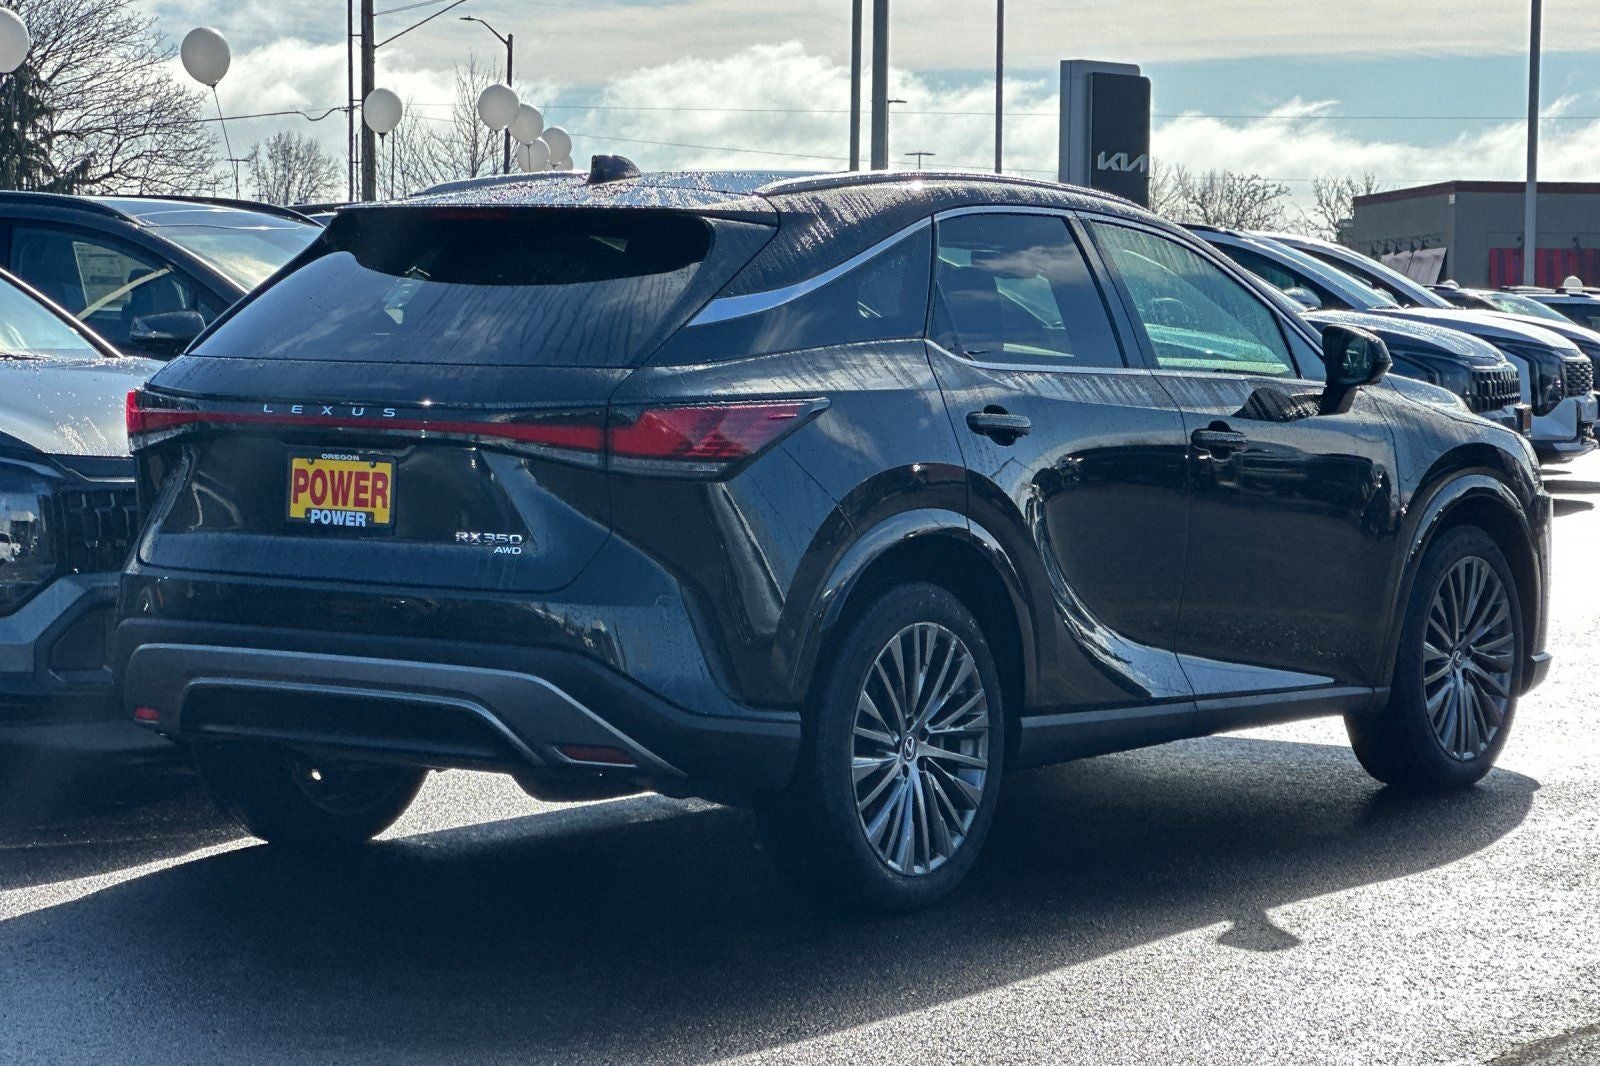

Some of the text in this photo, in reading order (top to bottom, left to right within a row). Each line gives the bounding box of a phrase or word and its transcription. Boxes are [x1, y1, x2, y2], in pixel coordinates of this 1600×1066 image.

[263, 404, 396, 417] LEXUS
[321, 453, 360, 461] OREGON
[292, 468, 389, 509] POWER
[310, 508, 367, 527] POWER
[493, 546, 522, 555] AWD
